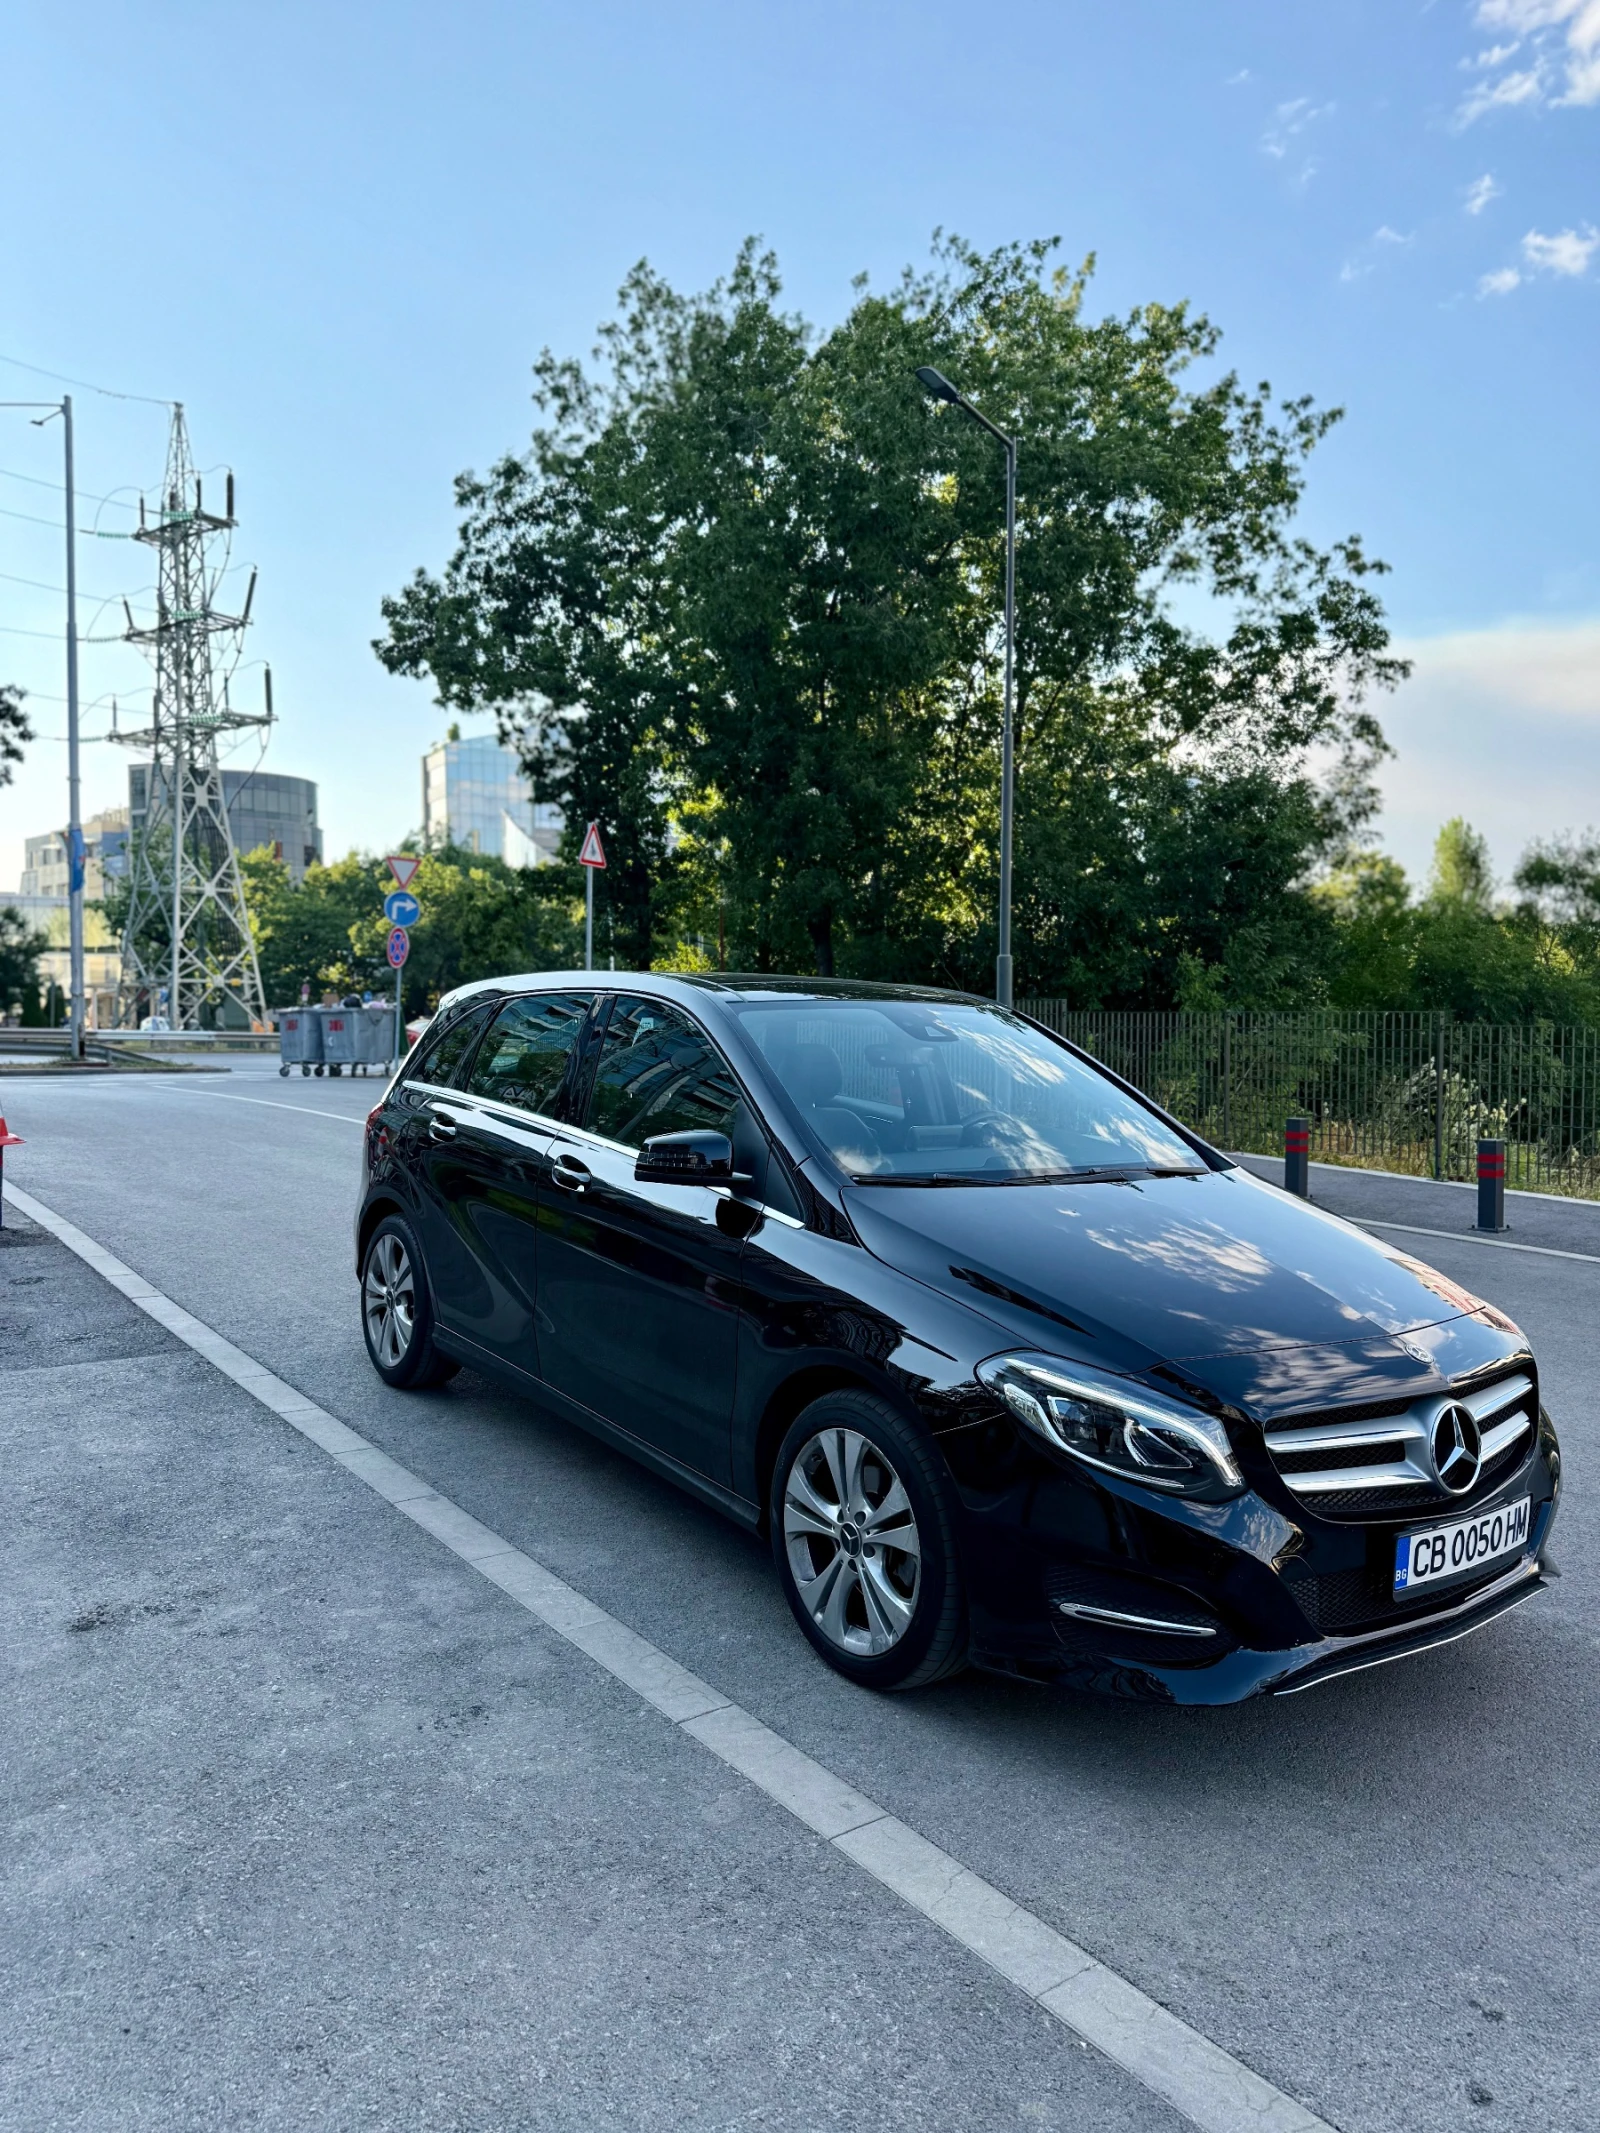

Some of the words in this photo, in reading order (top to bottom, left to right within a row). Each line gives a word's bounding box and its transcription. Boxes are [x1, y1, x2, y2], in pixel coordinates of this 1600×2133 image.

[1413, 1534, 1446, 1578] CB
[1452, 1515, 1503, 1567] 0050
[1504, 1502, 1528, 1548] HM
[1395, 1568, 1407, 1582] BG
